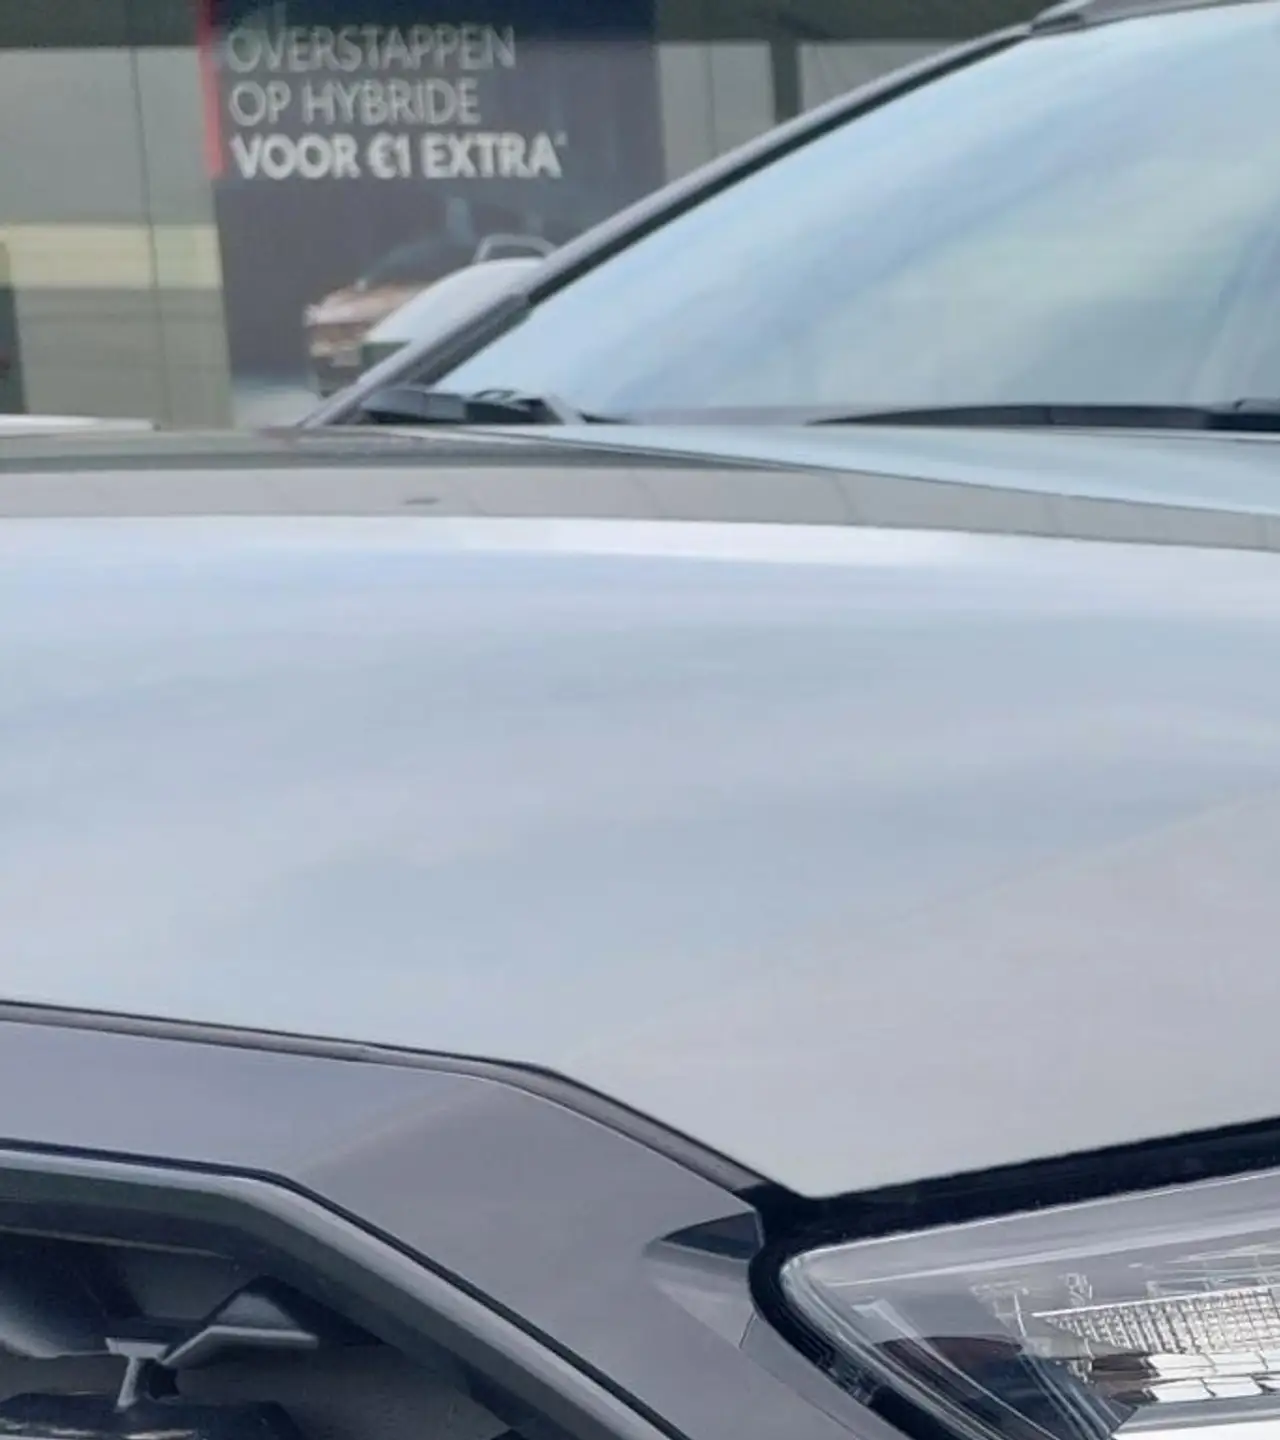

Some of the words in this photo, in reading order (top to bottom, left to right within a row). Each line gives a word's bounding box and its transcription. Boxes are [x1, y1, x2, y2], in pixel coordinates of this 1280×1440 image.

[228, 25, 514, 72] OVERSTAPPEN
[230, 79, 290, 126] OP
[303, 78, 481, 126] HYBRIDE
[230, 134, 360, 180] VOOR
[369, 133, 410, 179] €1
